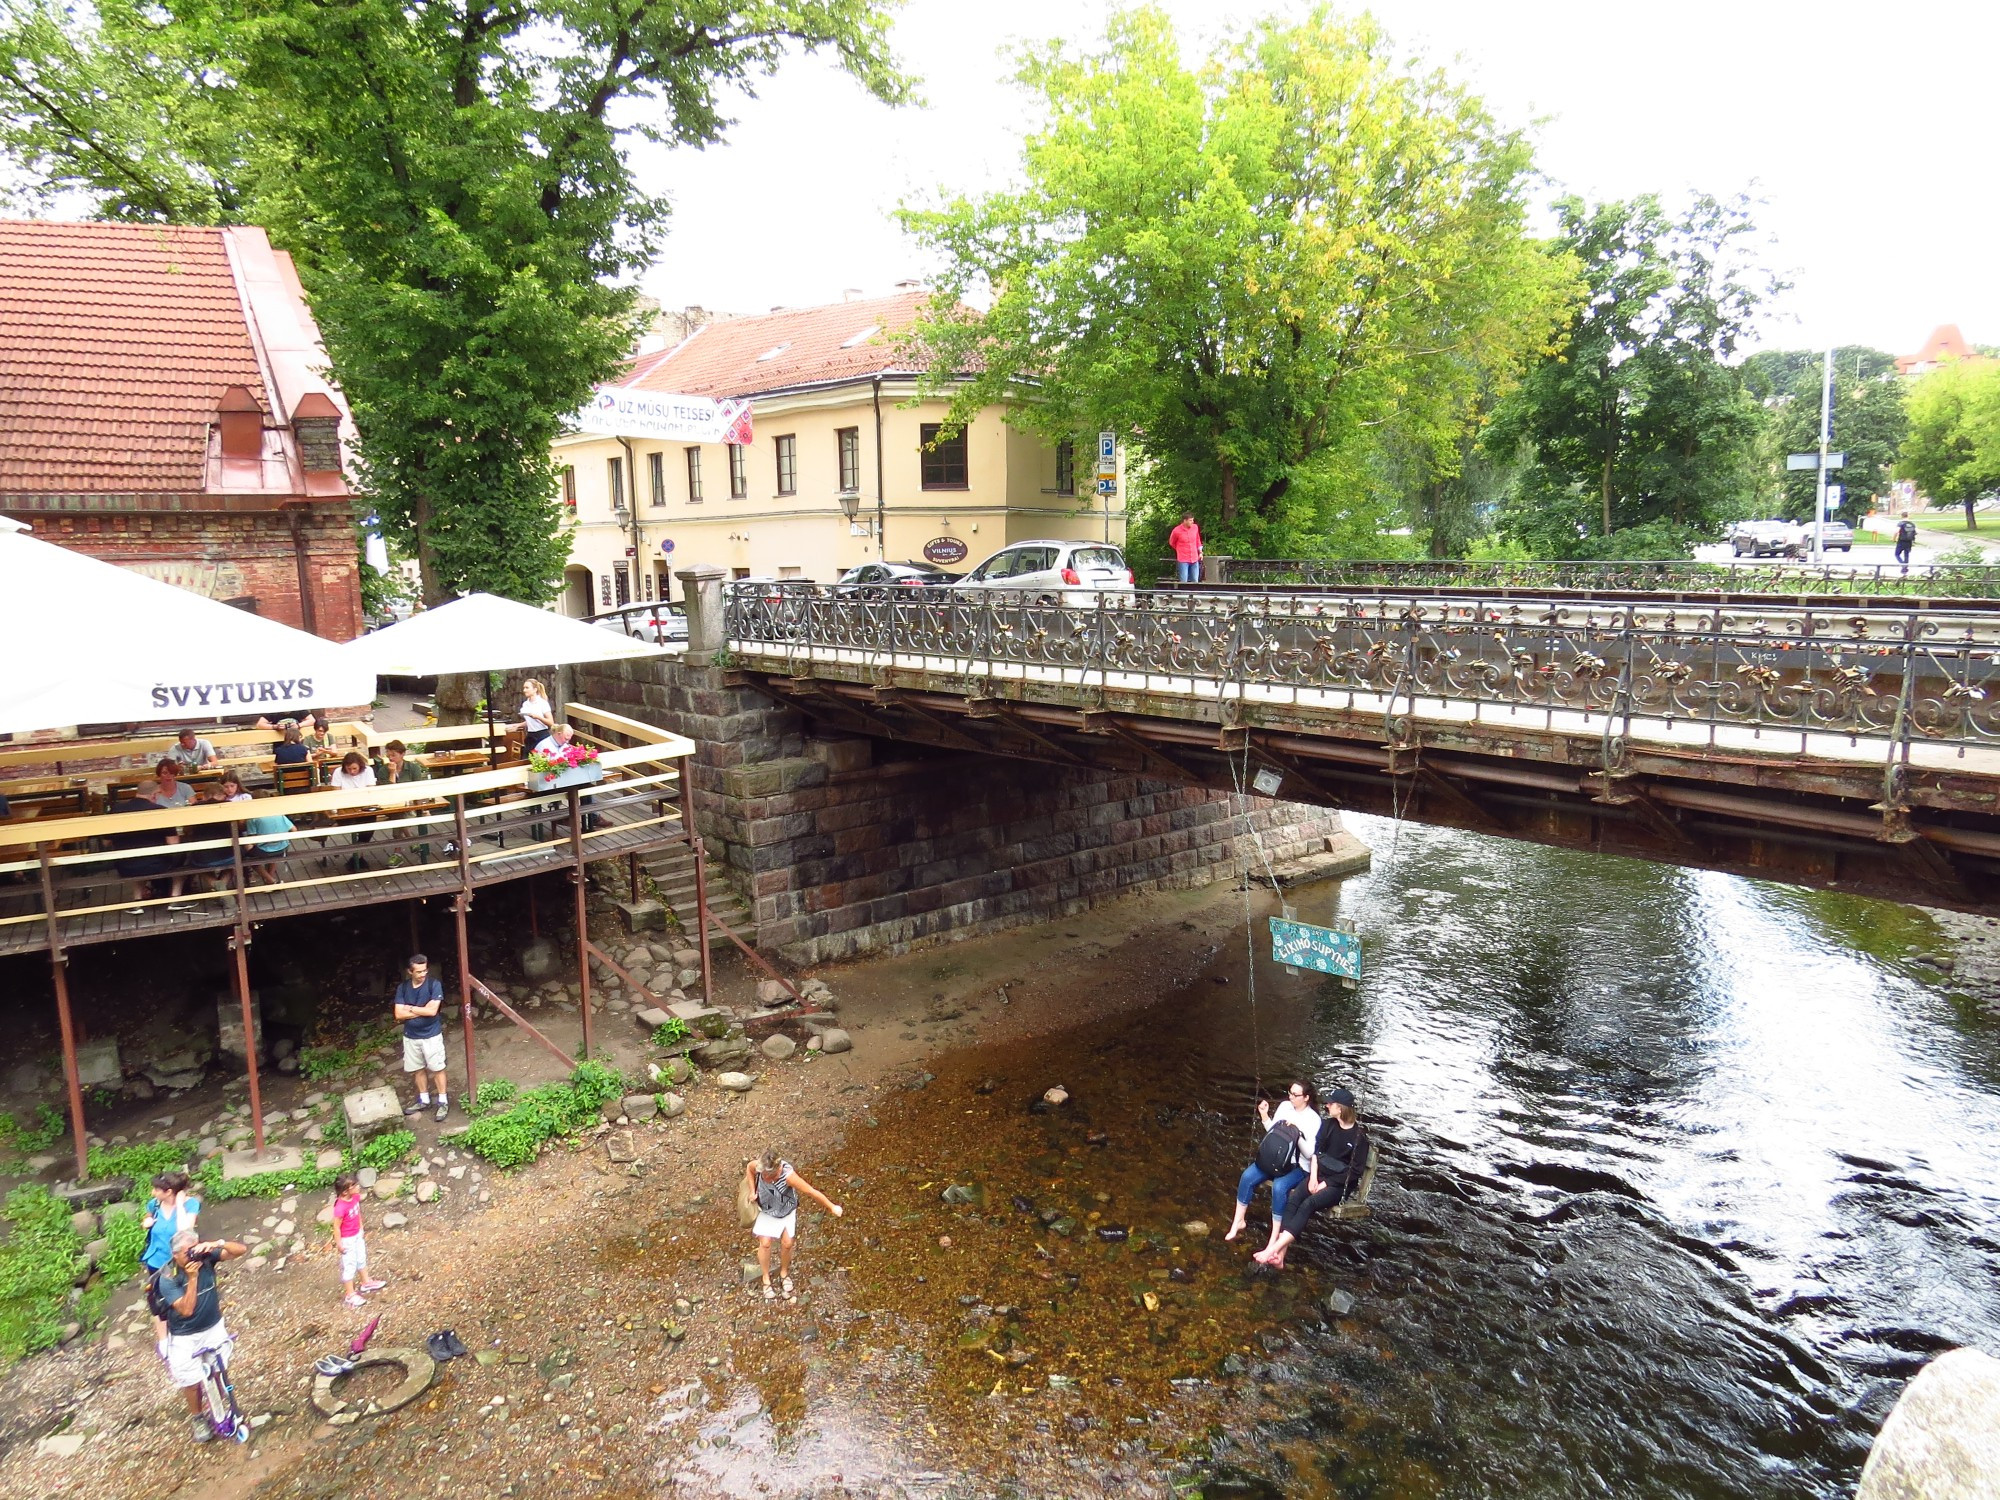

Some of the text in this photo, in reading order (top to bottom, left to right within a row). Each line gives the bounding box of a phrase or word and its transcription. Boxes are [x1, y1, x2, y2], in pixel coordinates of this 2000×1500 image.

[1103, 440, 1112, 454] P
[1099, 481, 1107, 494] P
[946, 538, 963, 547] TOURS
[151, 677, 314, 709] ŠVYTURYS
